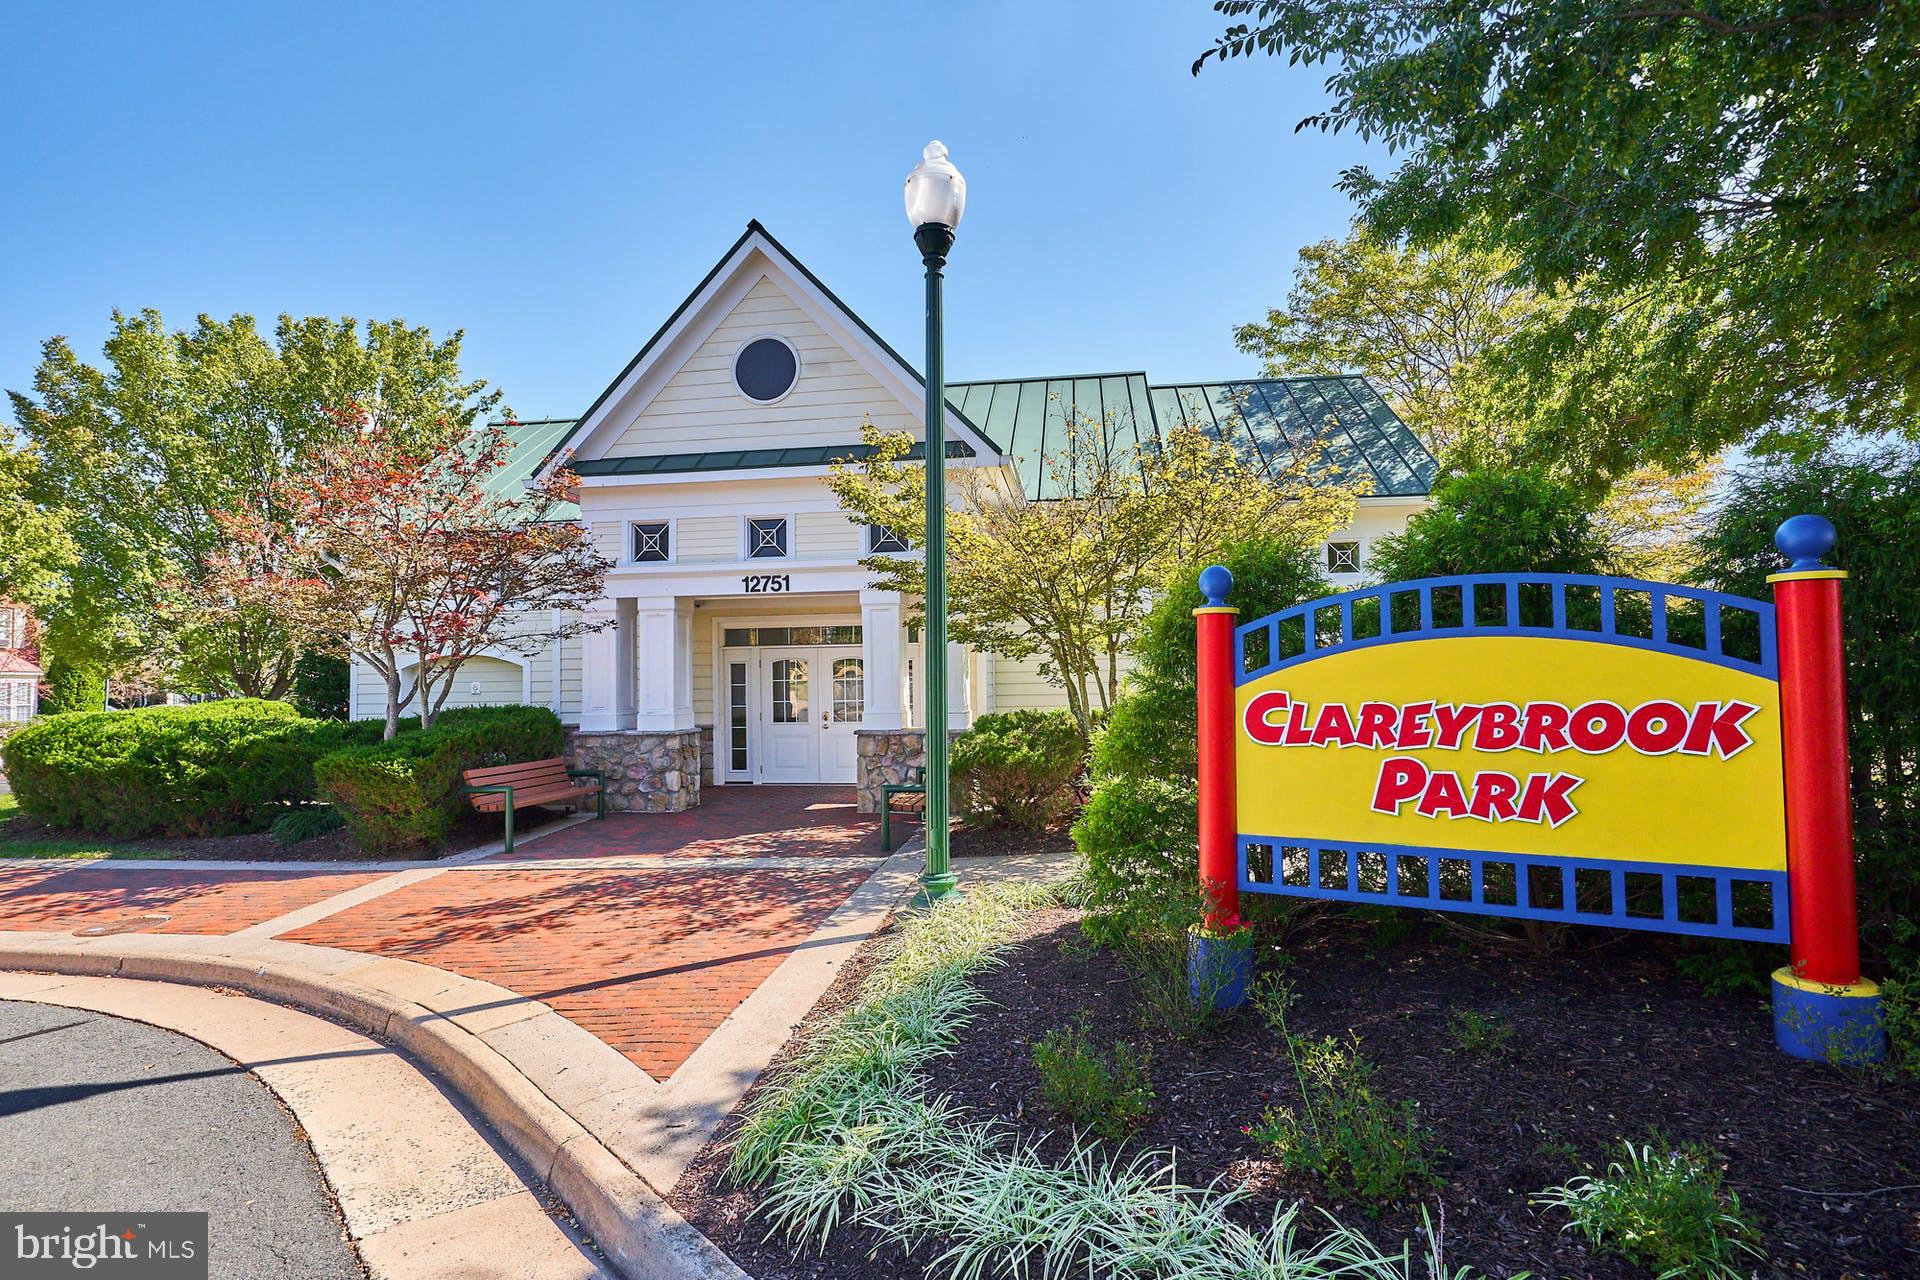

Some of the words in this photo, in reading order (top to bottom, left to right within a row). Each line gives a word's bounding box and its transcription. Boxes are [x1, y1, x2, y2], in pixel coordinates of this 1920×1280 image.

[741, 574, 790, 593] 12751
[1242, 690, 1762, 761] CLAREYBROOK
[1370, 756, 1586, 829] PARK
